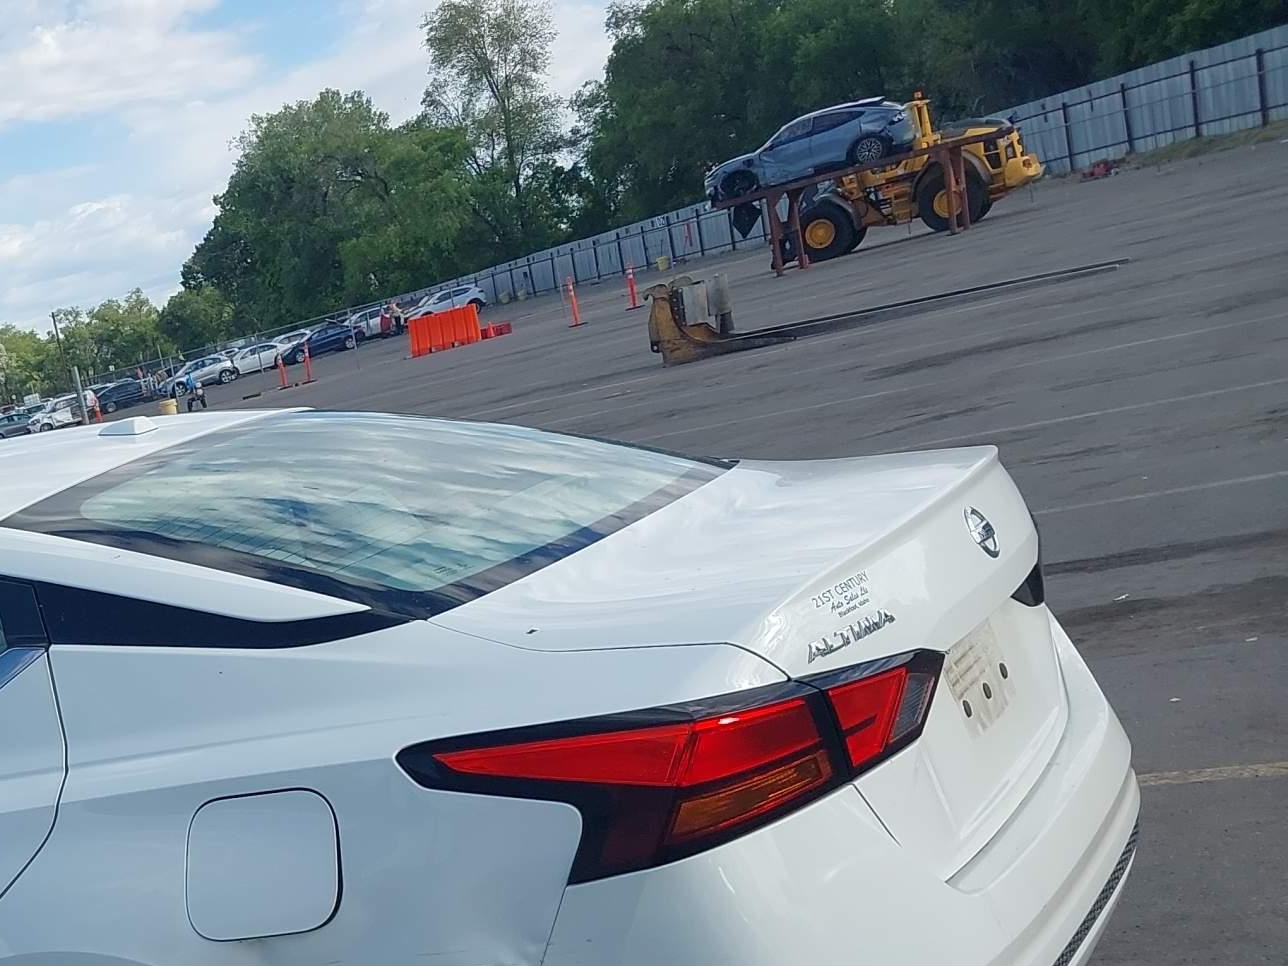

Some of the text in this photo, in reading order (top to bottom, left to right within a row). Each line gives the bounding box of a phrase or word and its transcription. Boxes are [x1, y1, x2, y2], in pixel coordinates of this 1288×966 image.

[812, 571, 869, 608] 21ST CENTURY
[808, 610, 896, 664] ALTIMA
